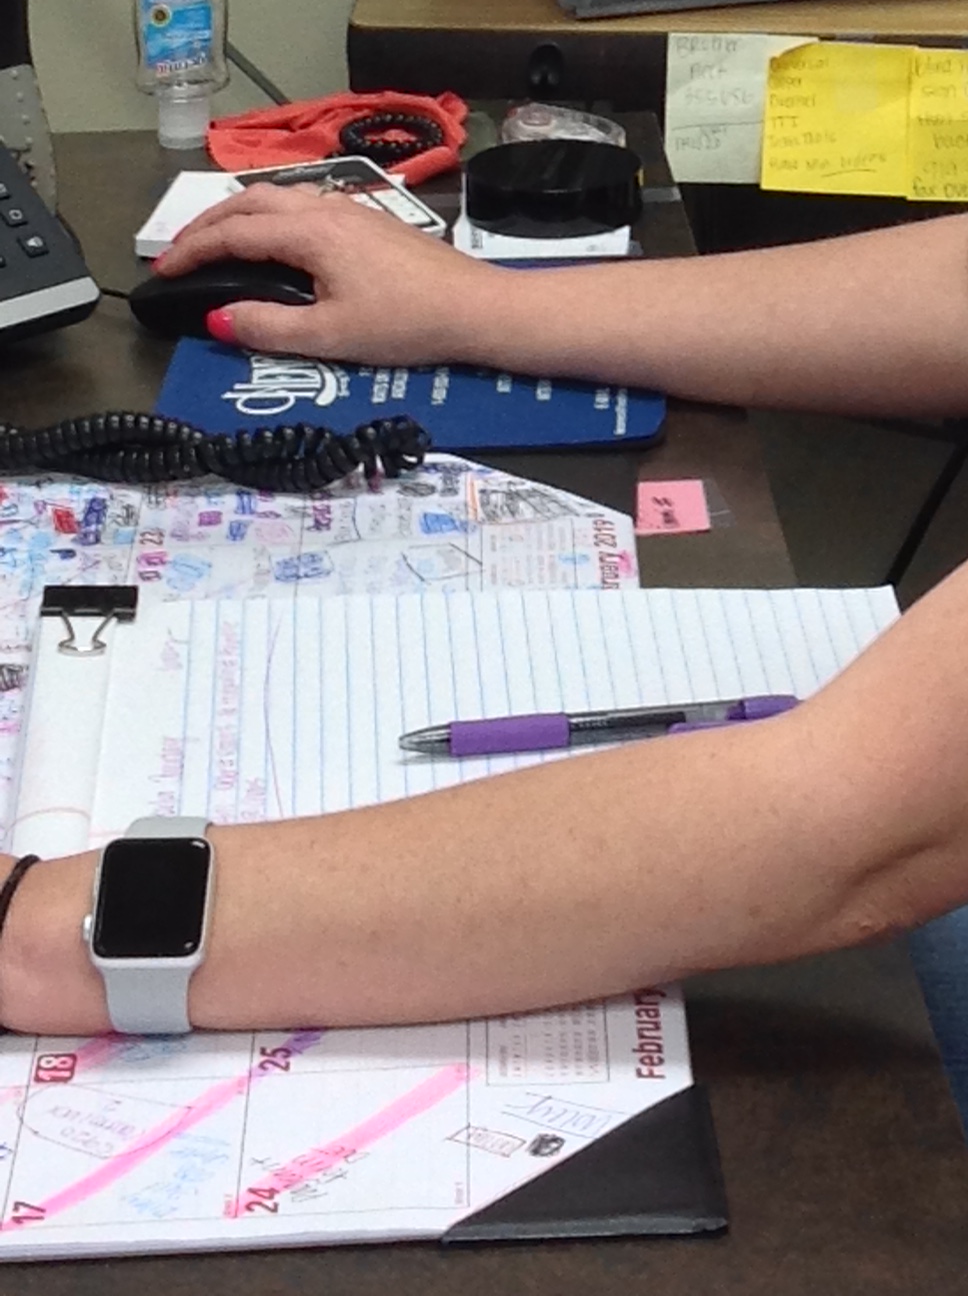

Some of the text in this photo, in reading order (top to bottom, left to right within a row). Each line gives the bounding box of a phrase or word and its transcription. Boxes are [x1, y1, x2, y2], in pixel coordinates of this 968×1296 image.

[592, 517, 618, 549] 2019
[630, 987, 667, 1078] February
[38, 1054, 74, 1082] 18
[259, 1047, 293, 1071] 25
[12, 1201, 46, 1224] 17
[244, 1188, 280, 1215] 24
